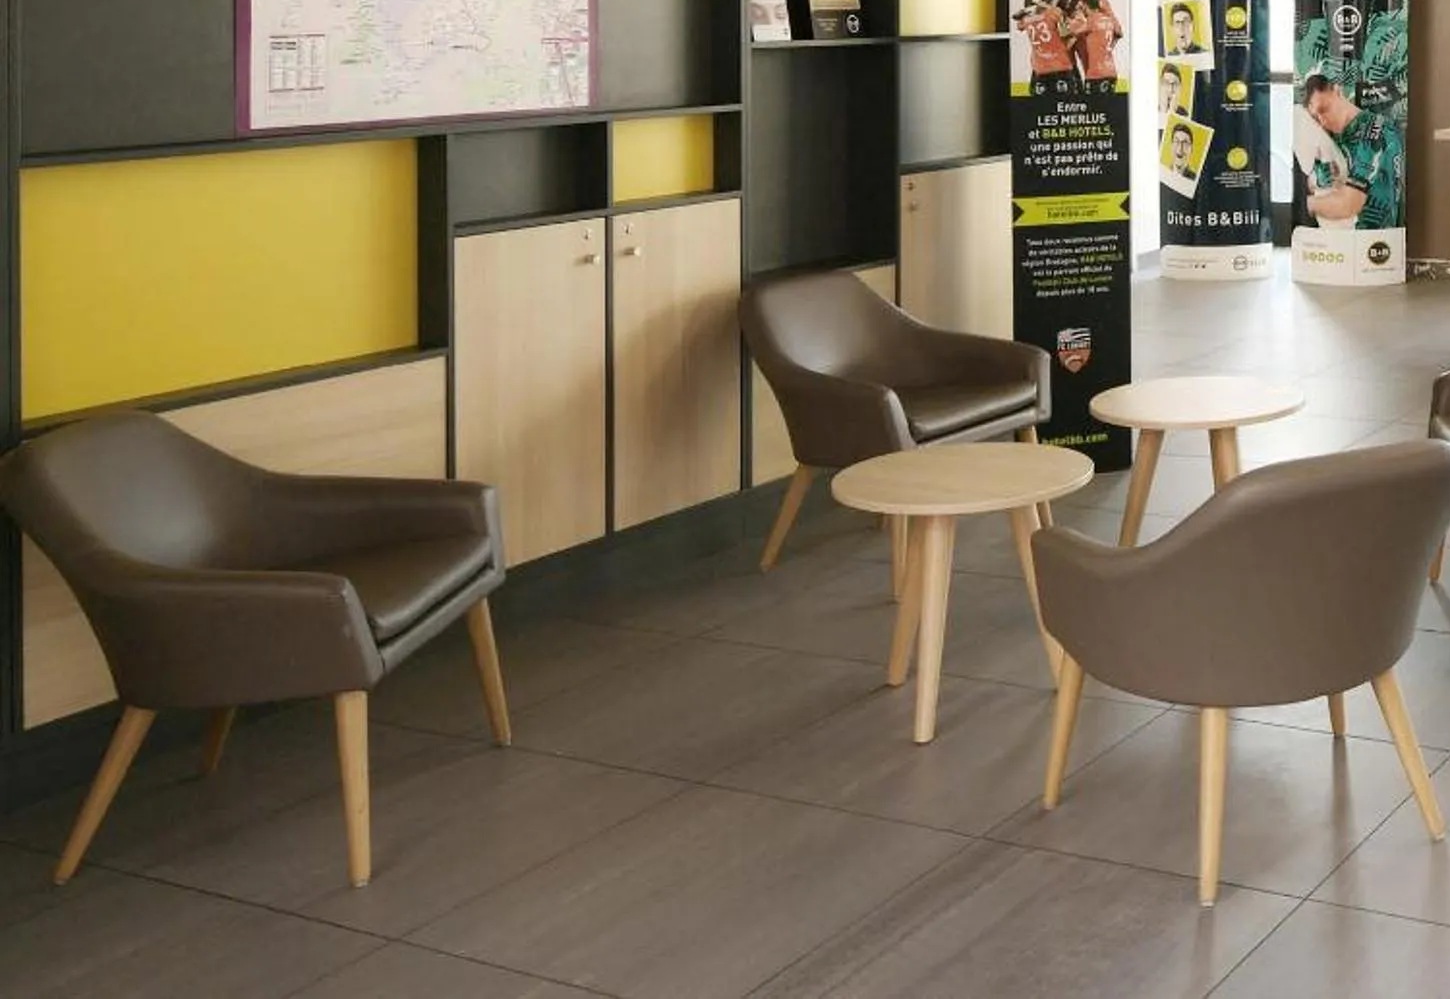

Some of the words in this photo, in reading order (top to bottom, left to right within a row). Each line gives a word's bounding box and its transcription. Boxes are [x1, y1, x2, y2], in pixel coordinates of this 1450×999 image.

[1057, 102, 1087, 112] Entre
[1037, 115, 1058, 126] LES
[1061, 113, 1107, 125] MERLUS
[1028, 128, 1040, 140] et
[1042, 127, 1066, 138] B&B
[1030, 143, 1051, 152] une
[1053, 140, 1095, 153] passion
[1096, 139, 1113, 151] qui
[1024, 155, 1052, 165] n'est
[1055, 156, 1074, 166] pas
[1106, 150, 1118, 161] de
[1042, 165, 1103, 177] s'endormir.
[1167, 211, 1202, 226] Dites
